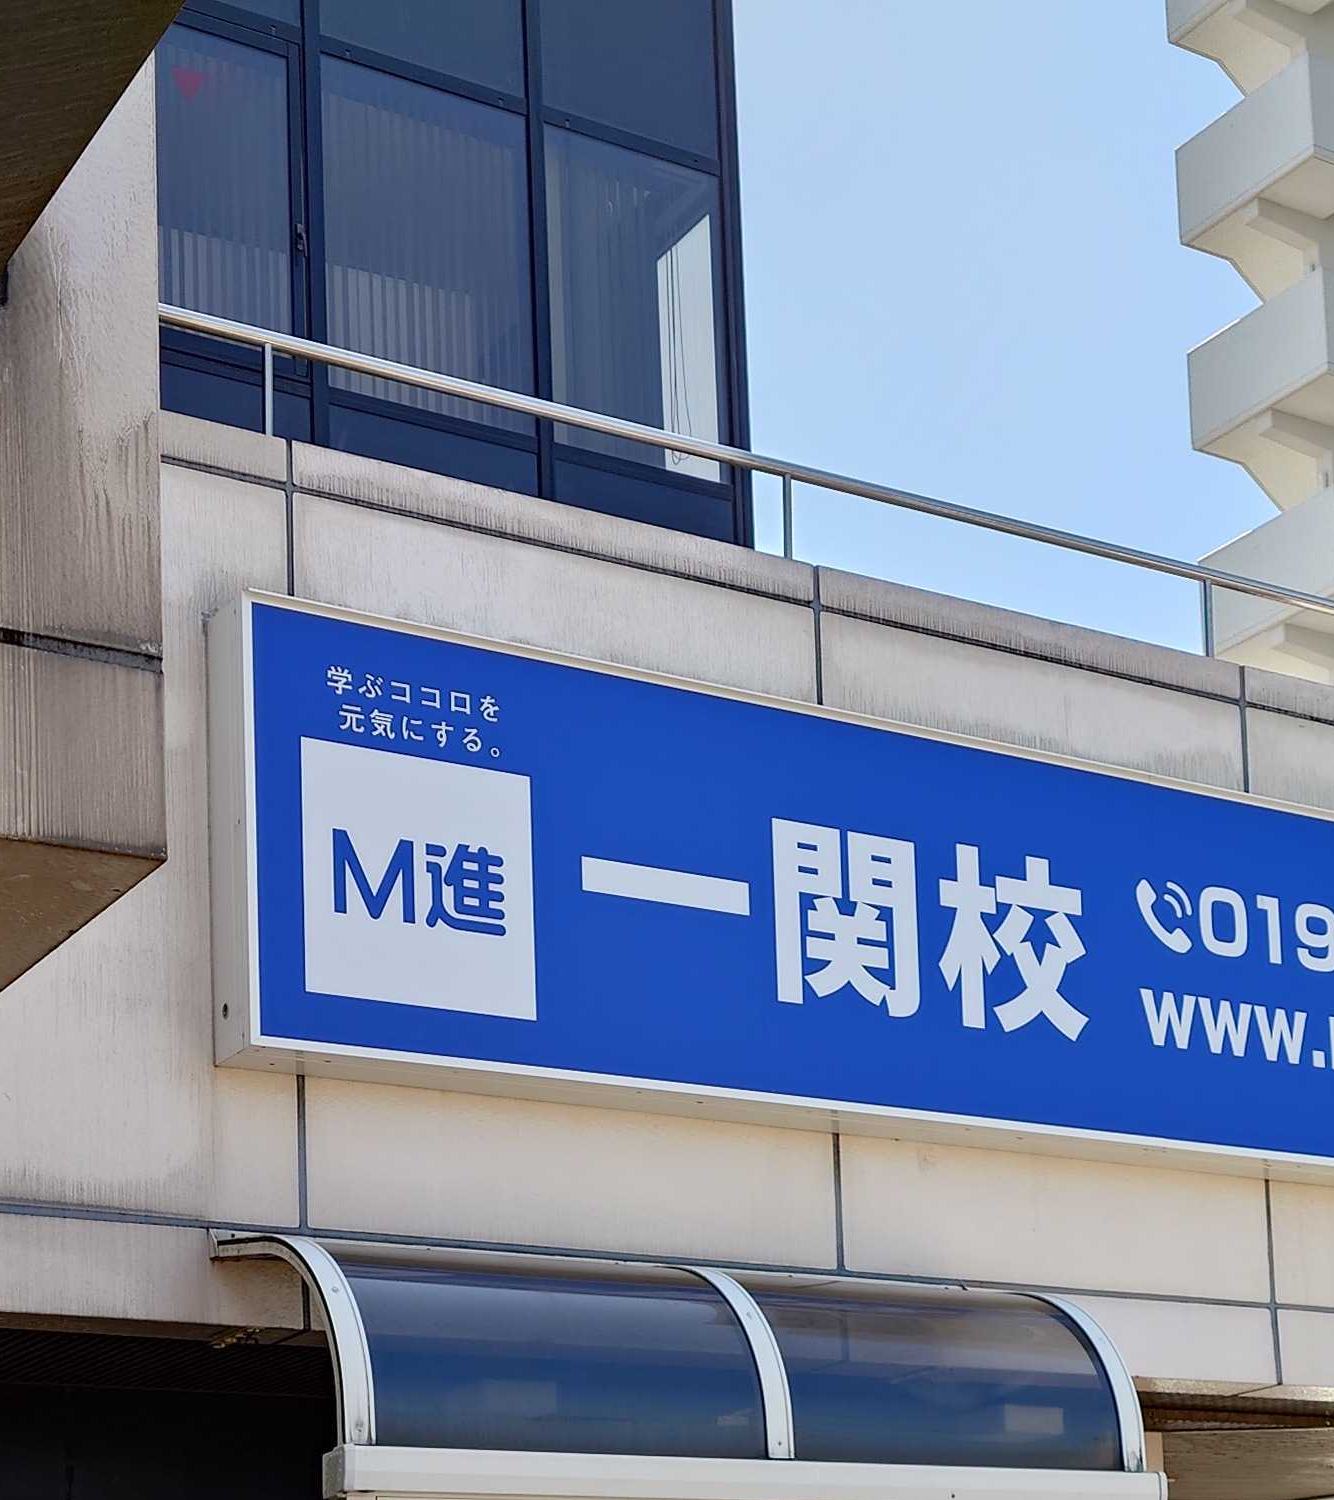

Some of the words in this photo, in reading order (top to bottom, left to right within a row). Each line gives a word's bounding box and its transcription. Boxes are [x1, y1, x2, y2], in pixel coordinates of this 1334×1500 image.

[326, 666, 501, 723] 学ぶココロを
[339, 704, 500, 758] 元気にする。
[332, 827, 507, 937] M進
[581, 817, 1089, 1042] 一関校
